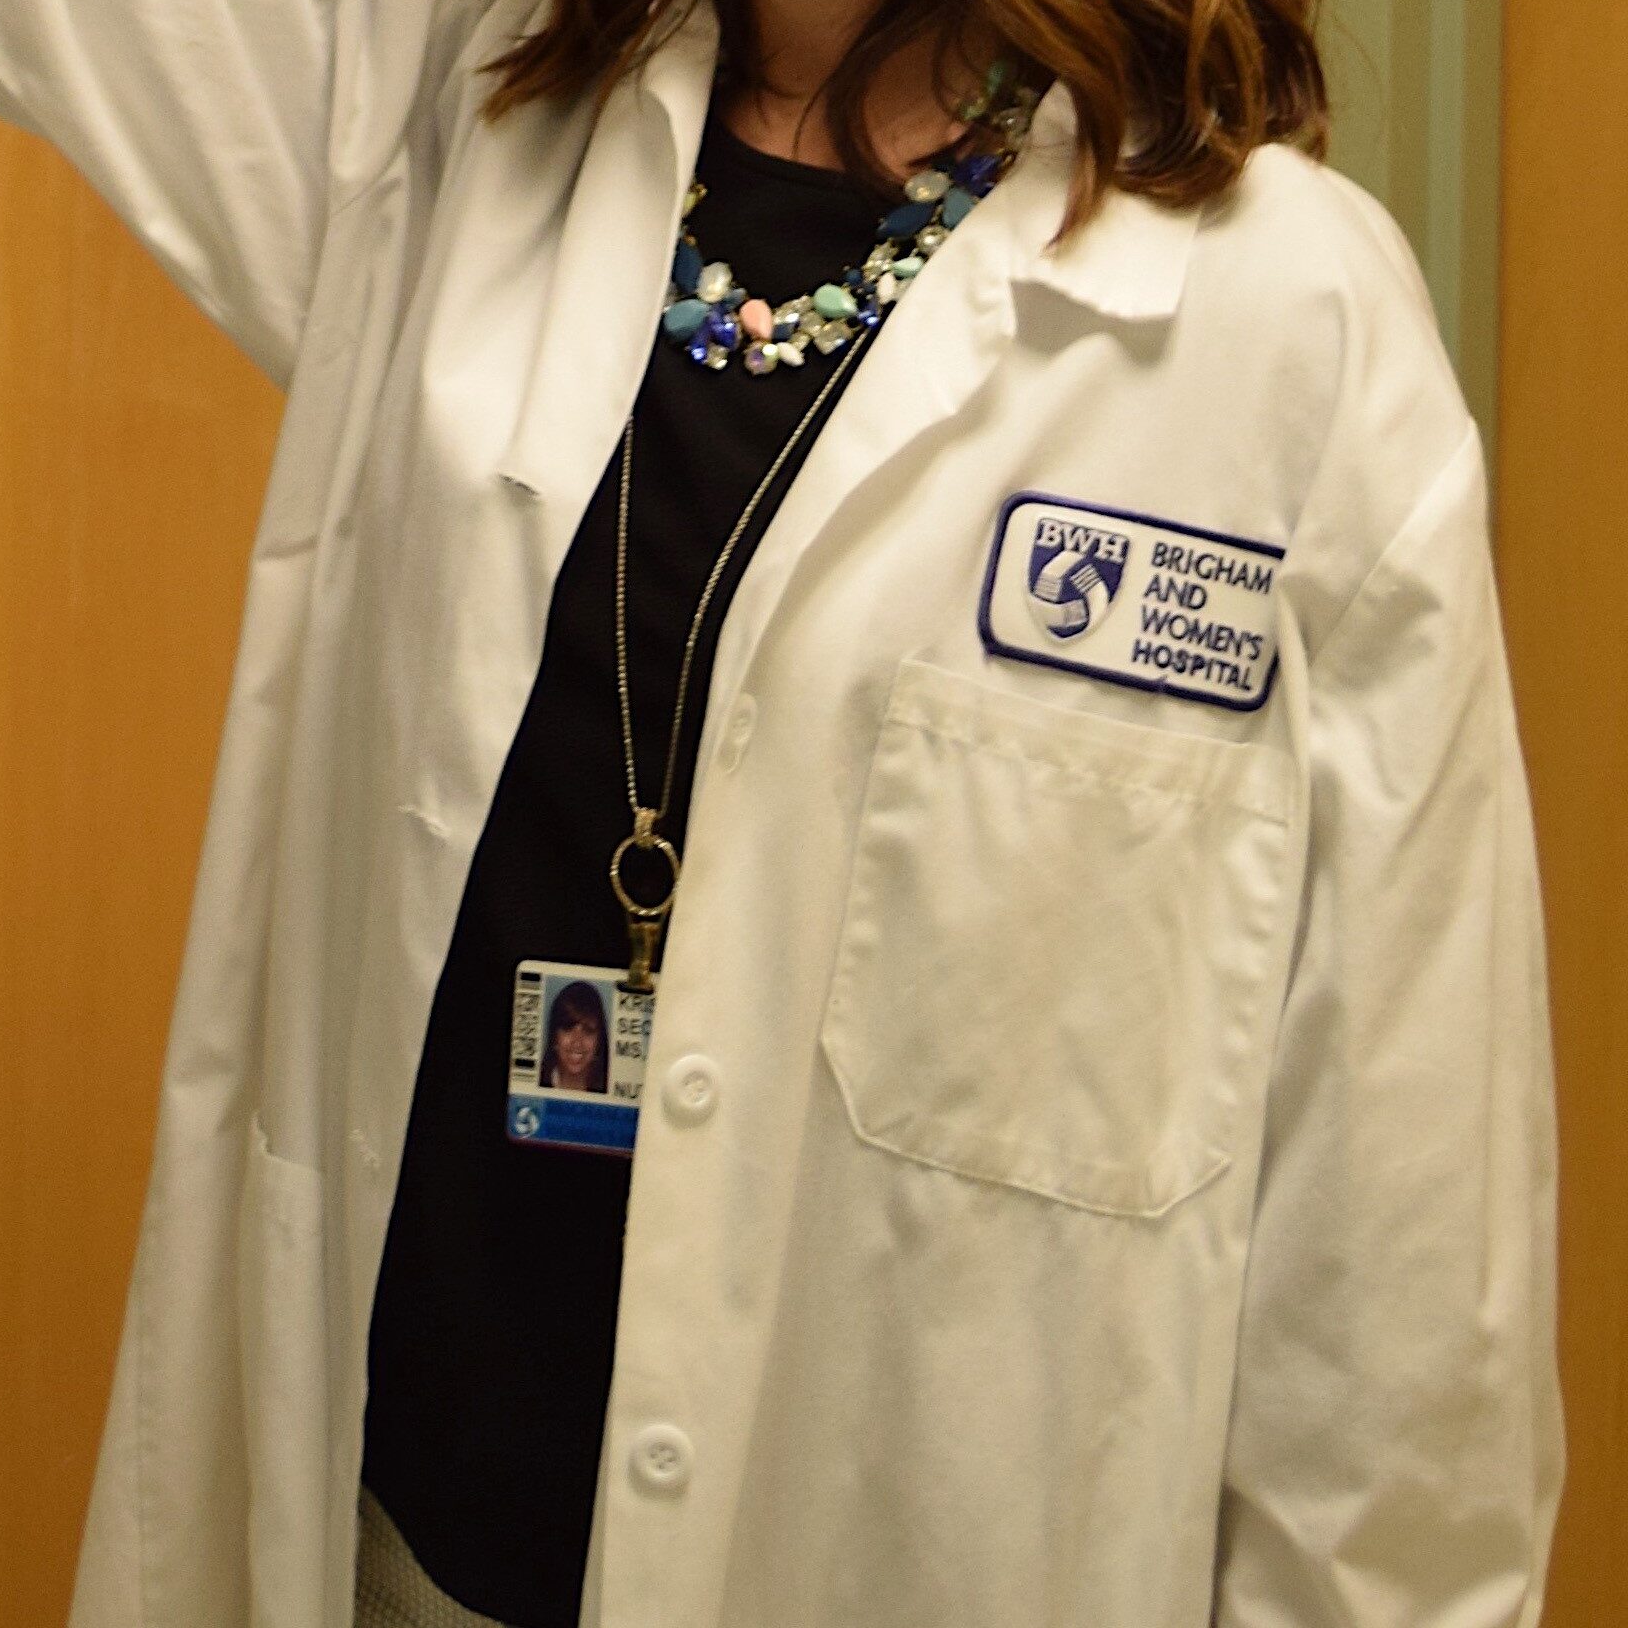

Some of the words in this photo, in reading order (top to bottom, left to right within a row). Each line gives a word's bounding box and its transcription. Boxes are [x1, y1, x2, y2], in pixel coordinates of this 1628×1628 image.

[1036, 517, 1126, 564] BWH
[1143, 573, 1208, 610] AND
[1151, 541, 1273, 594] BRIGHAM
[1141, 605, 1264, 661] WOMEN'S
[1132, 638, 1252, 691] HOSPITAL
